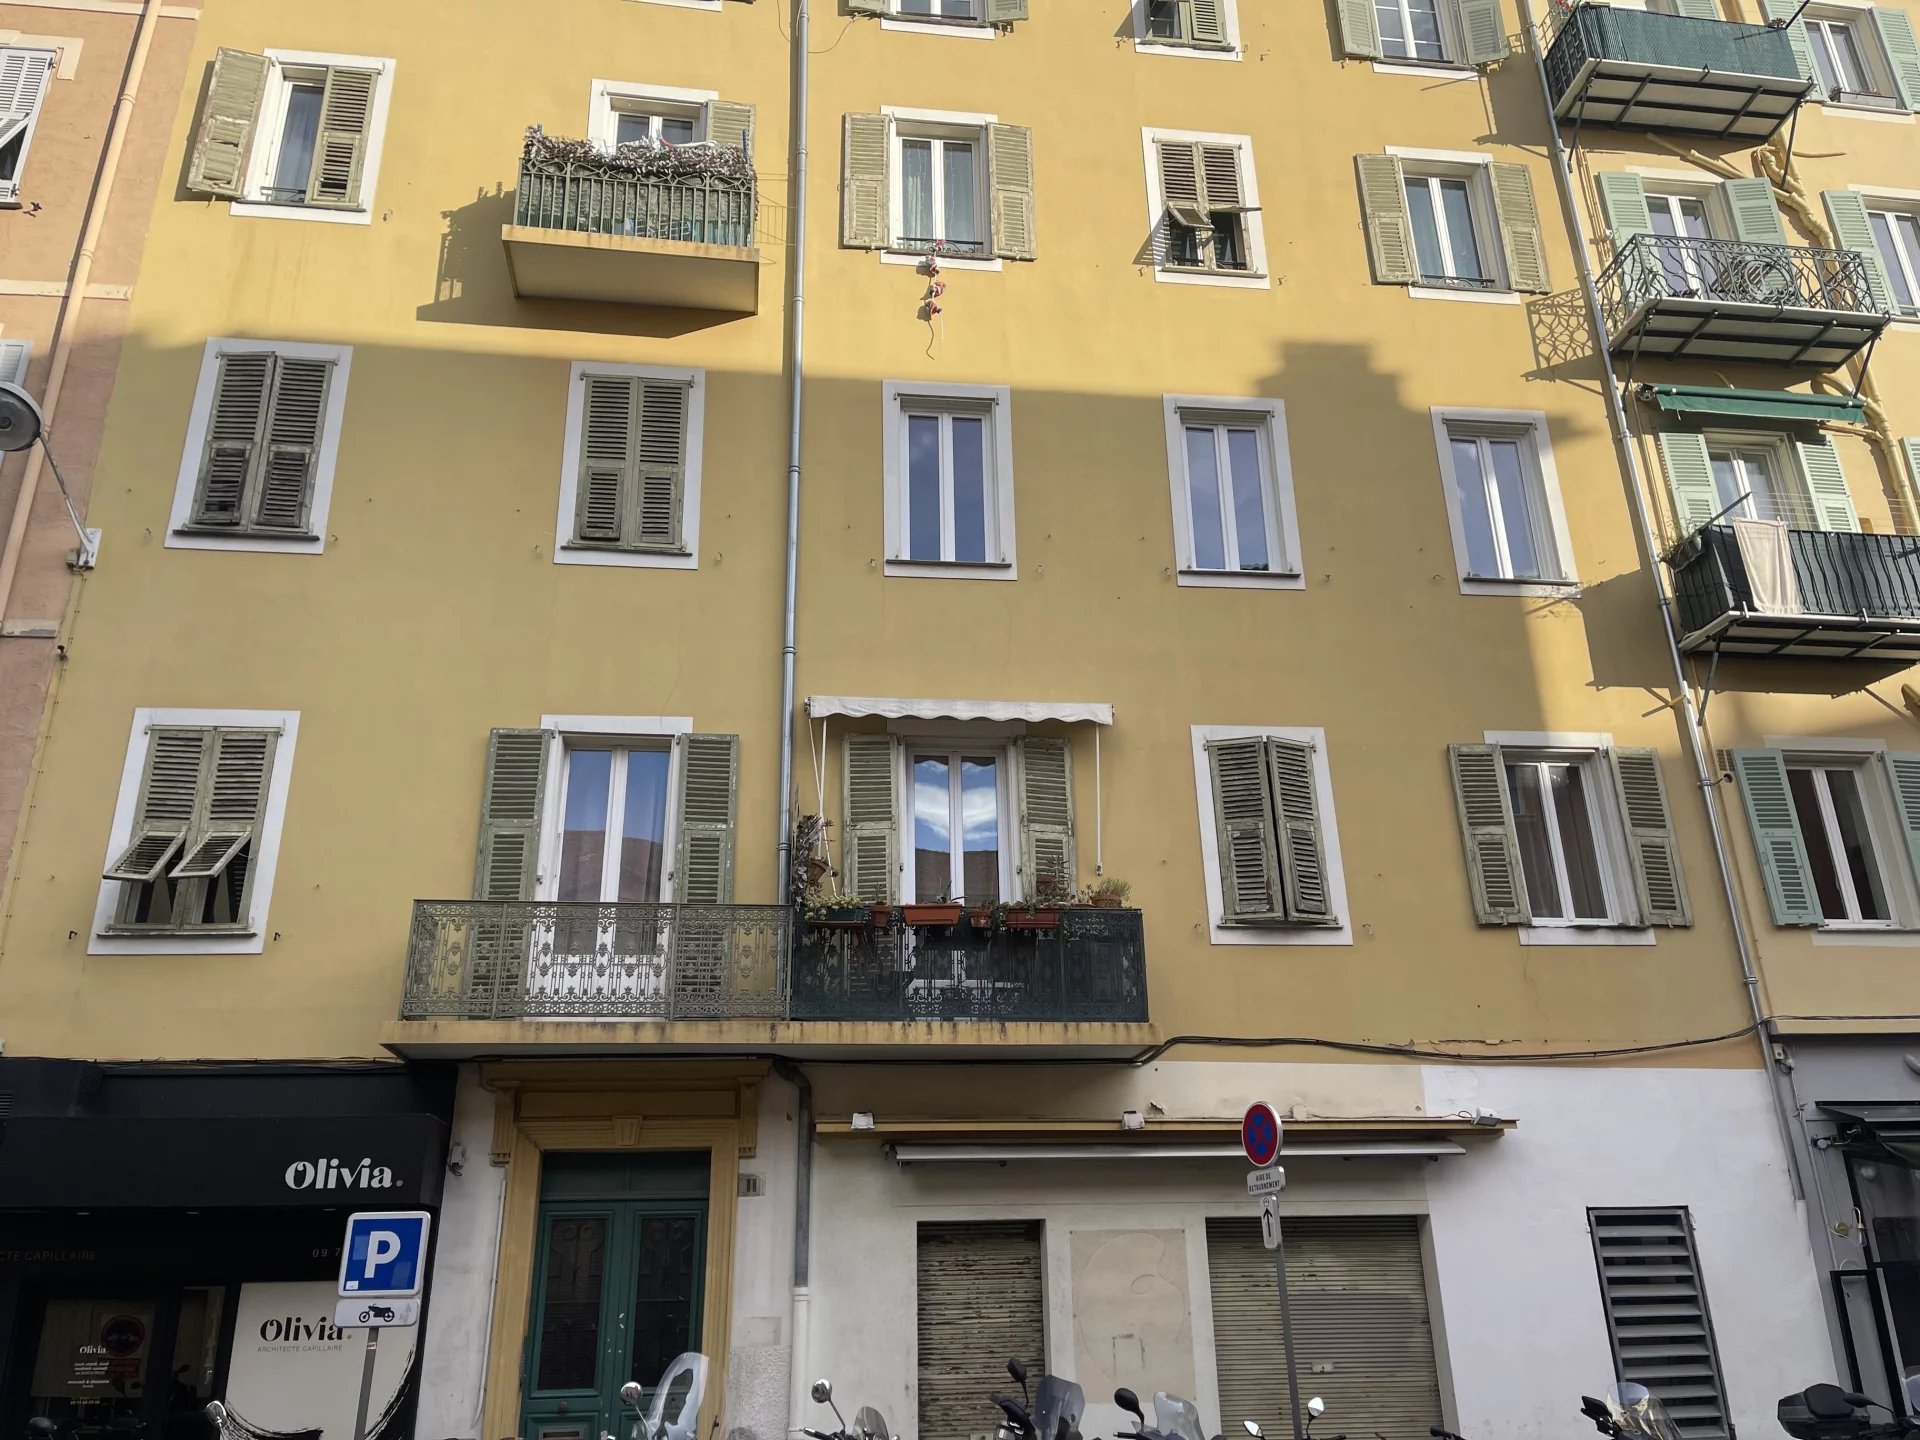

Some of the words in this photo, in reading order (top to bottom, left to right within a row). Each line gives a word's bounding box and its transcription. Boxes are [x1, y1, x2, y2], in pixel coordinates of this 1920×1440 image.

[1249, 1180, 1280, 1192] RETOURNEMENT
[24, 1251, 96, 1261] CAPILLAIRE
[312, 1248, 328, 1258] 09
[364, 1230, 401, 1279] P
[257, 1345, 301, 1353] ARCHITECTE
[302, 1344, 343, 1352] CAPILLAIRE
